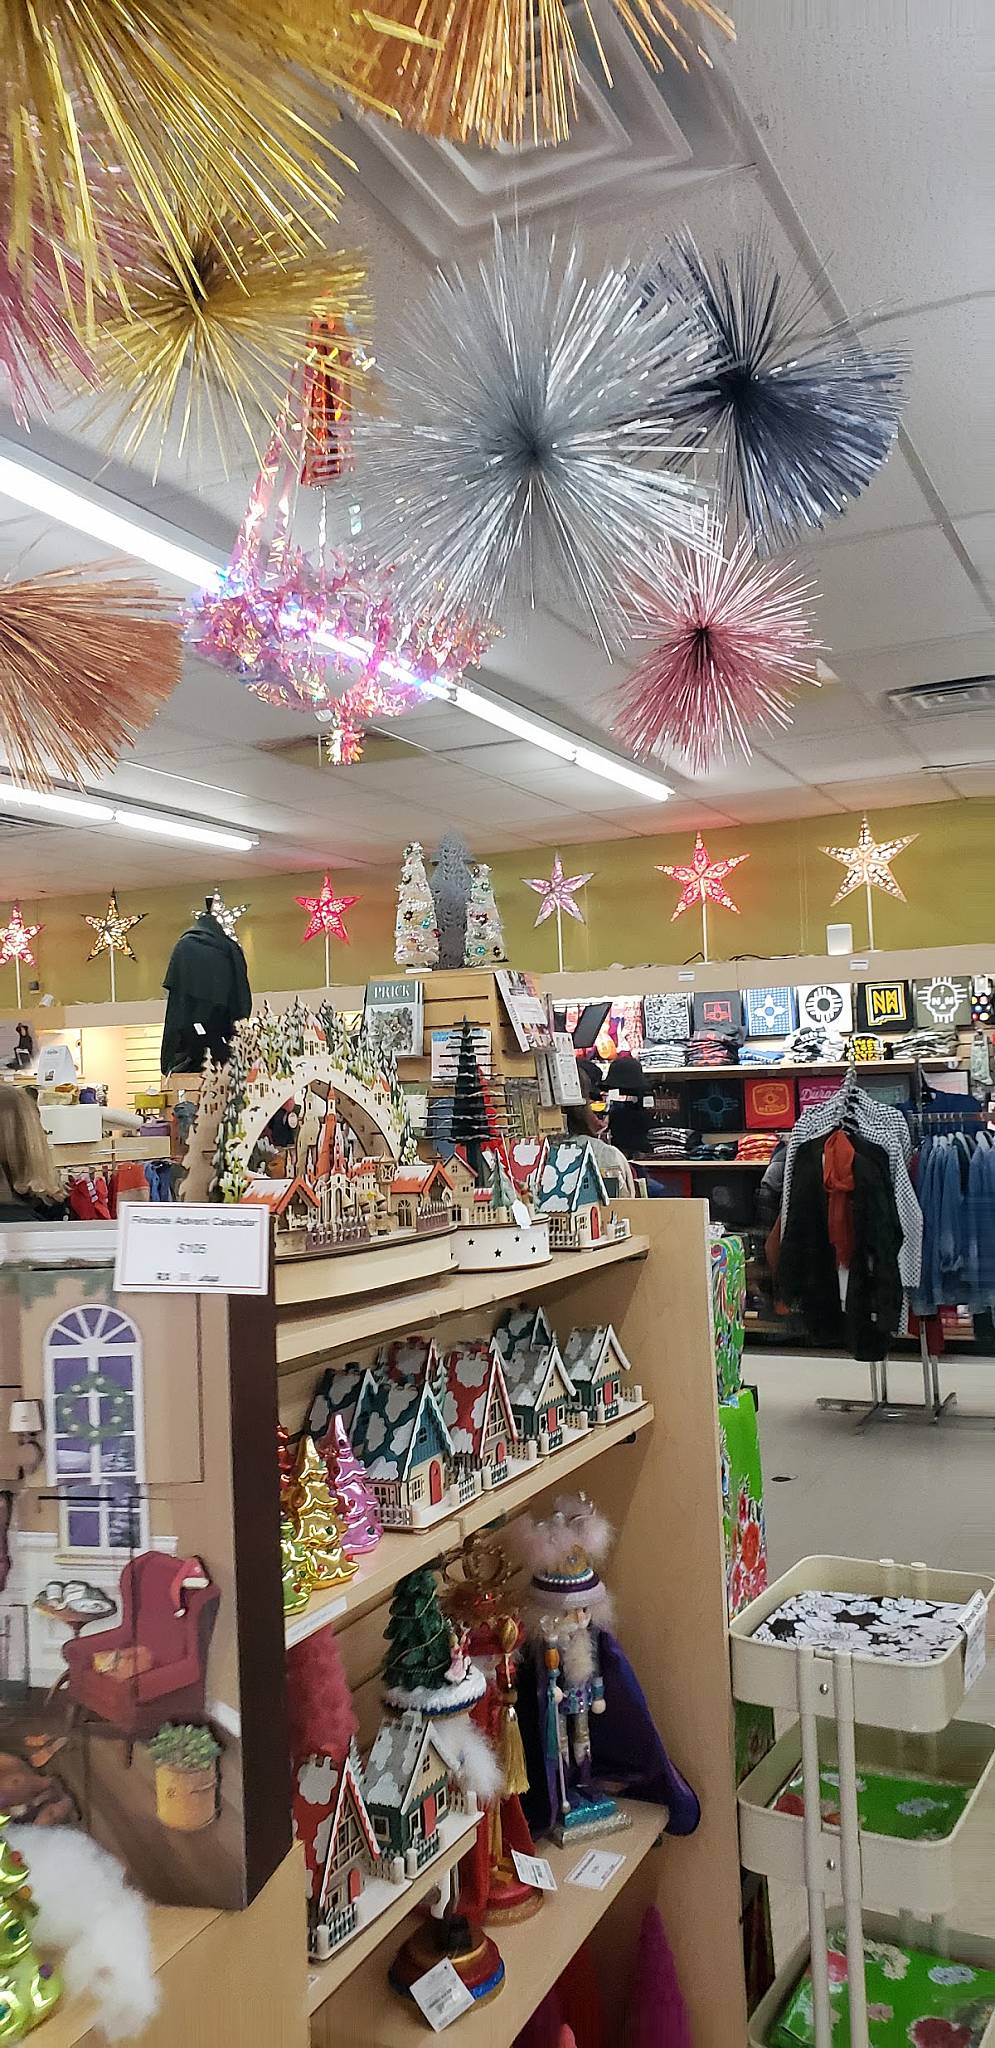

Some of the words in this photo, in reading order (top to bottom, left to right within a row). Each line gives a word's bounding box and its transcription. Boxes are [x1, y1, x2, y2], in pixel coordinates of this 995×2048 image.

[374, 985, 410, 998] PRICK
[872, 990, 899, 1014] NM
[131, 1215, 171, 1225] Fireside
[175, 1216, 209, 1226] Advent
[213, 1217, 258, 1227] Calendar
